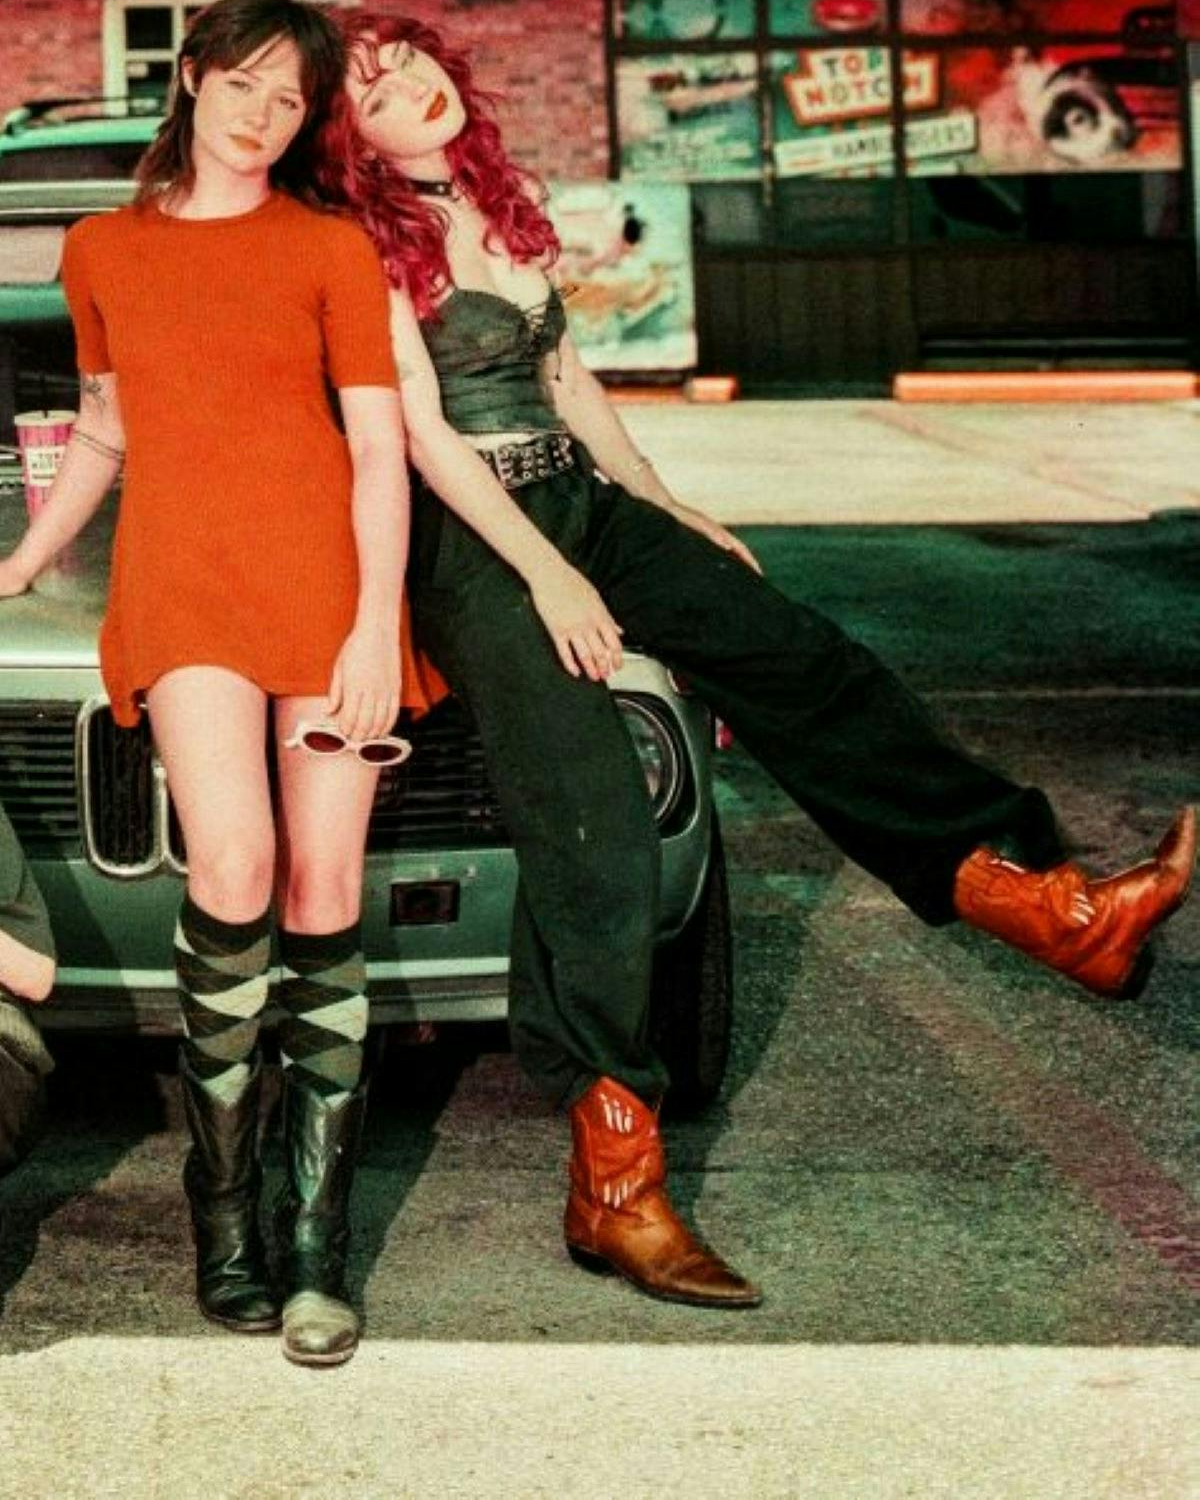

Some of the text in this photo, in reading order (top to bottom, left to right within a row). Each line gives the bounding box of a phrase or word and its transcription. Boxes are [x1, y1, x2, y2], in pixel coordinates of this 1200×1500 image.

[823, 48, 883, 77] TOP
[806, 74, 921, 104] NOTCH
[831, 121, 968, 158] HAMBRGERS
